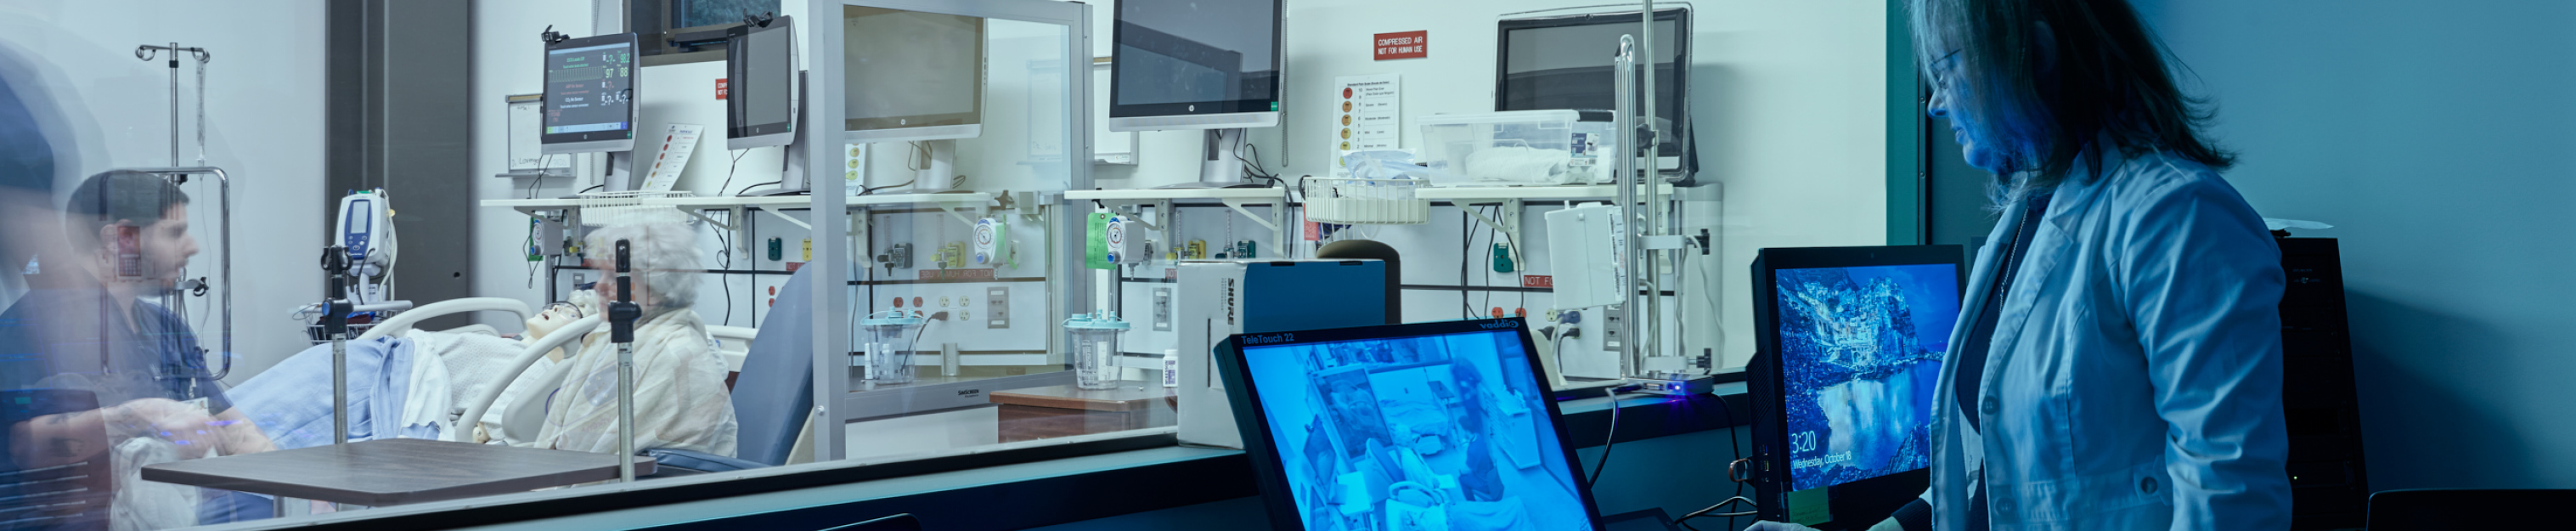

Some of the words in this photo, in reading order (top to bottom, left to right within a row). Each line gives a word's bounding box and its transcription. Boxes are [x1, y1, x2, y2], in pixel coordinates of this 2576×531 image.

[1378, 37, 1412, 46] COMPRESSED
[606, 68, 614, 78] 97
[620, 67, 628, 76] 88
[1480, 319, 1519, 329] vaddio
[1241, 334, 1282, 344] TeleTouch
[1284, 333, 1294, 342] 22
[1792, 431, 1816, 454] 3:20
[1793, 456, 1823, 469] Wednesday,
[1824, 453, 1845, 464] October
[1846, 450, 1852, 460] 18
